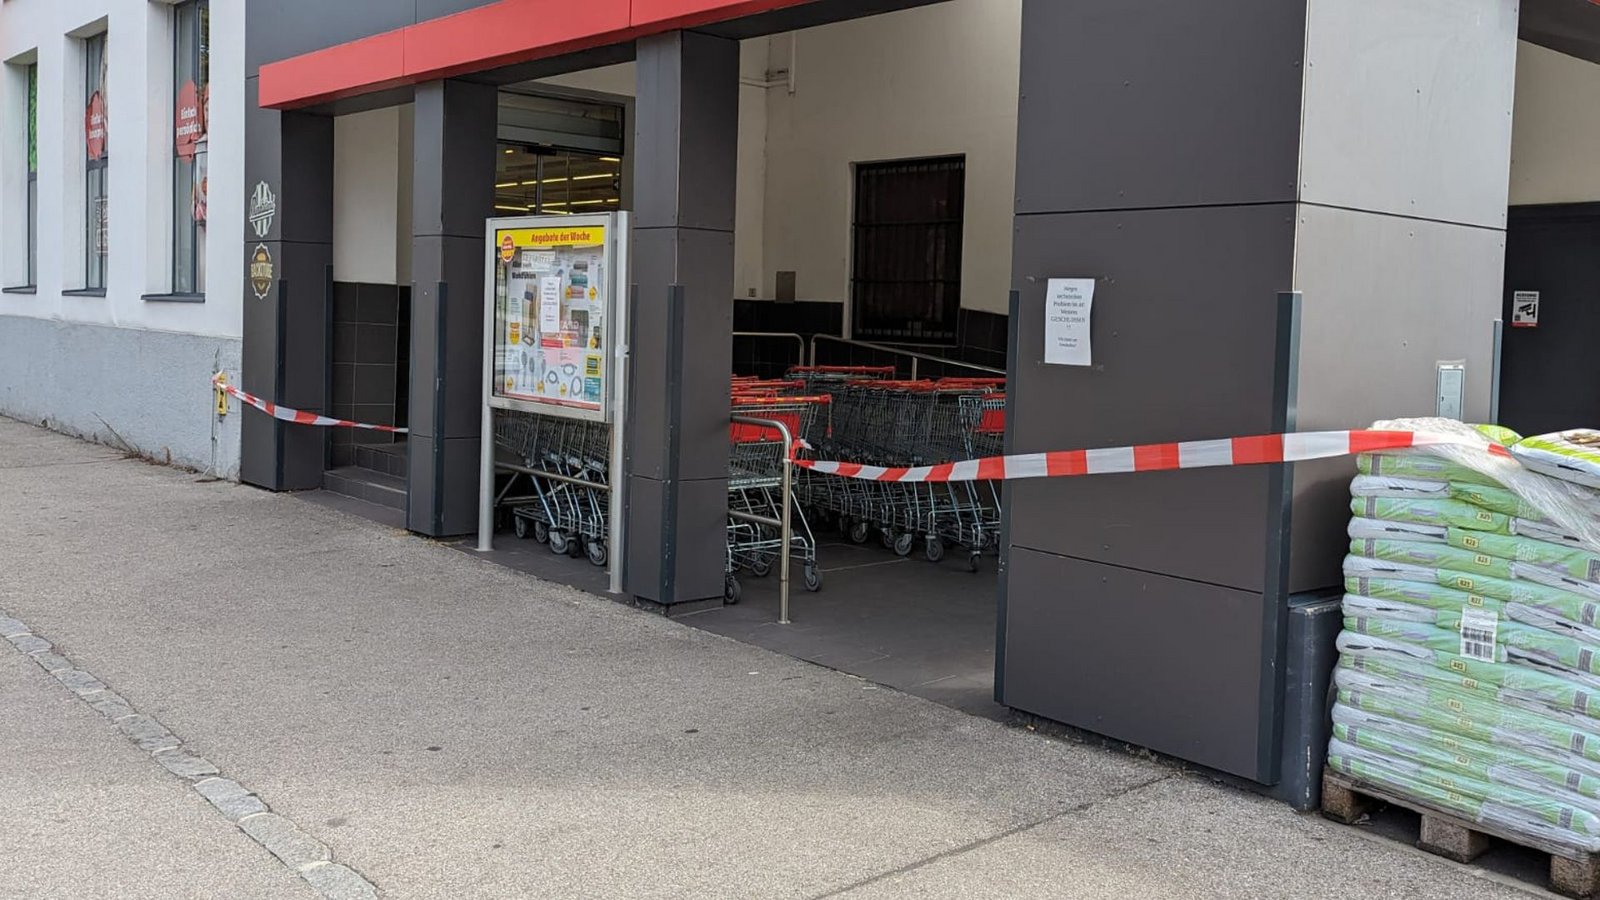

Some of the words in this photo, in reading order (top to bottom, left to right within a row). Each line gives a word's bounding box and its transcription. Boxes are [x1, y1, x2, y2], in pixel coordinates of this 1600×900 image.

[531, 233, 559, 244] Angebote
[560, 232, 570, 241] der
[570, 231, 590, 240] Woche
